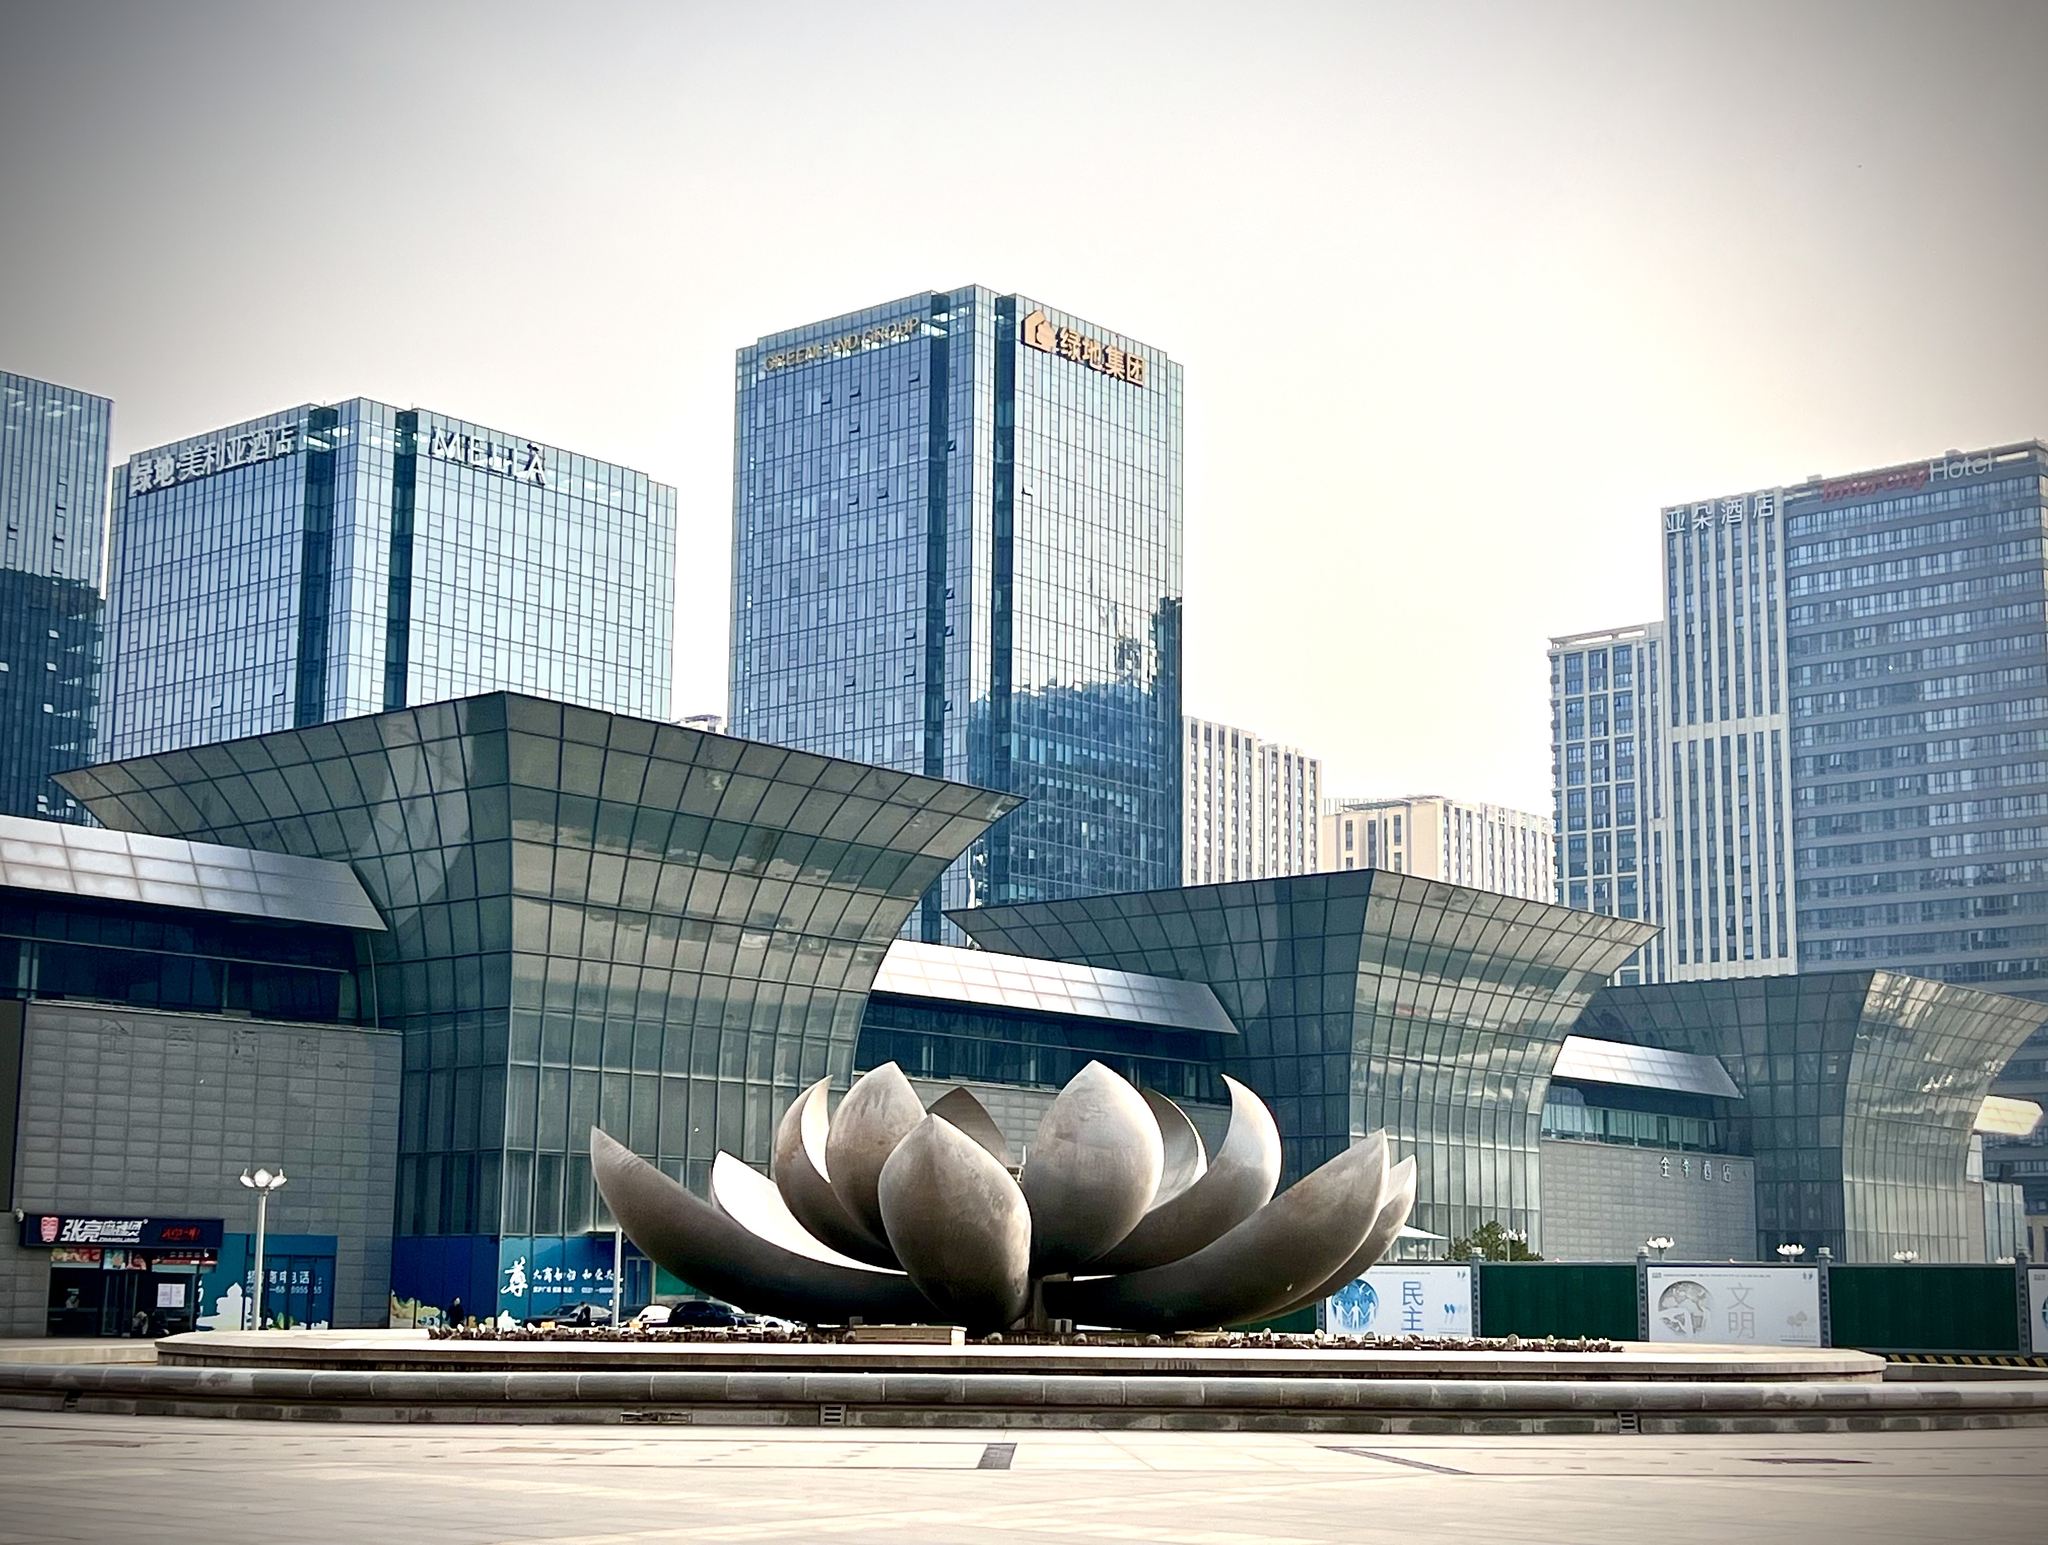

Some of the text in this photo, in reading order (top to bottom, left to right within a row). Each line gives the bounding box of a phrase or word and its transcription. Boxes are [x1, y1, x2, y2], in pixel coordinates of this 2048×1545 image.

[764, 317, 920, 372] GREENLAND GROUP
[1059, 326, 1146, 387] 绿地集团
[1665, 493, 1775, 533] 亚朵酒店
[1401, 1280, 1425, 1332] 民主
[1726, 1281, 1757, 1340] 文明
